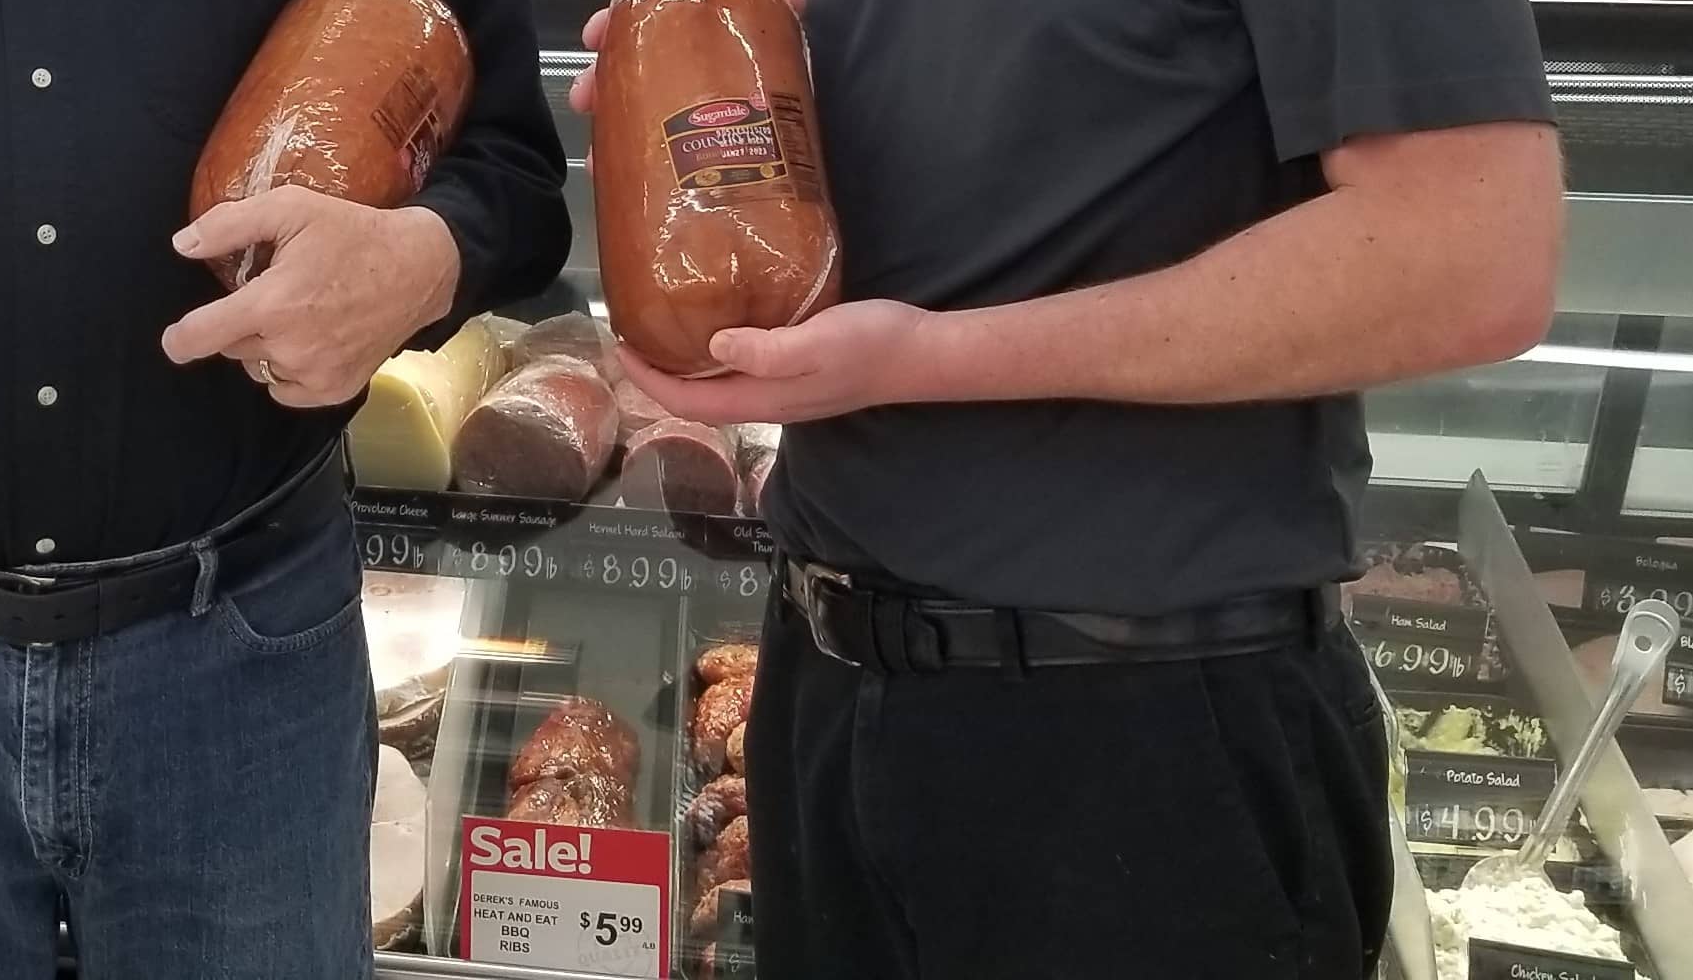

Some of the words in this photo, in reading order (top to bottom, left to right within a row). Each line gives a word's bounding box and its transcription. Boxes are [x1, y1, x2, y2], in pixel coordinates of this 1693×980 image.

[691, 101, 748, 124] Sugardale
[399, 504, 429, 517] Cheese
[451, 508, 477, 522] Large
[519, 512, 557, 528] Sausage
[733, 526, 752, 538] Old
[1635, 555, 1678, 570] Bologna
[1391, 614, 1412, 626] Ham
[1415, 617, 1446, 631] Salad
[1446, 769, 1484, 784] Potato
[1486, 771, 1521, 787] Salad
[469, 825, 592, 875] Sale!
[473, 893, 514, 906] DEREK'S
[519, 898, 560, 910] FAMOUS
[473, 908, 505, 921] HEAT
[508, 911, 532, 923] AND
[535, 913, 559, 926] EAT
[501, 925, 530, 939] BBQ
[499, 939, 530, 953] RIBS
